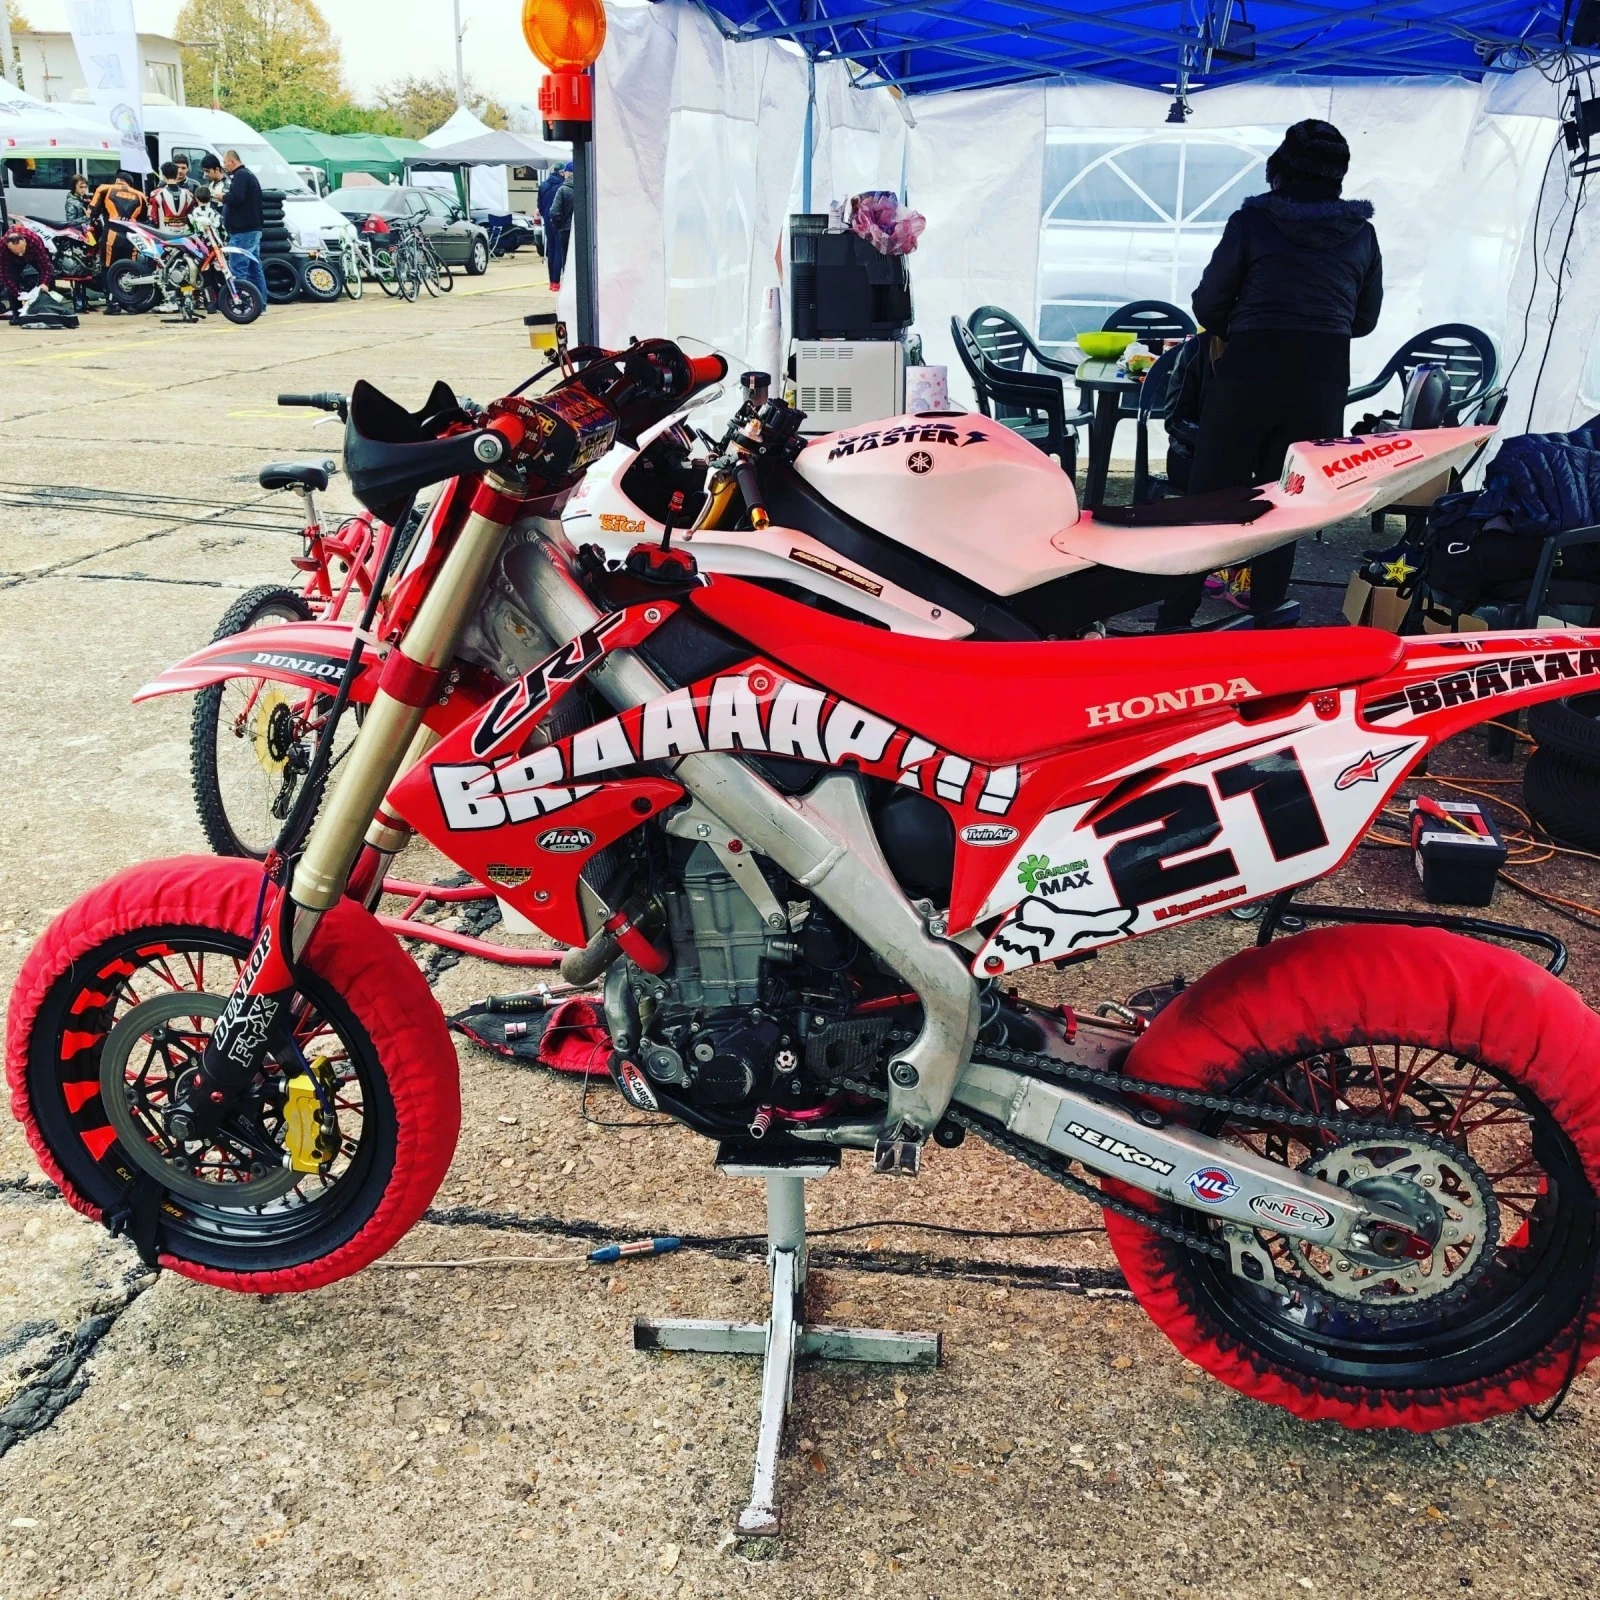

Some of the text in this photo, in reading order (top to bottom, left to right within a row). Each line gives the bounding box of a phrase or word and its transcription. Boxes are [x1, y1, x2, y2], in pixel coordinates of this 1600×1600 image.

[827, 429, 960, 464] MASTER
[1322, 438, 1413, 478] KIMBO
[472, 608, 626, 757] CRF
[1085, 677, 1261, 728] HONDA
[540, 830, 590, 845] Airoh
[1092, 746, 1330, 906] 21
[1035, 859, 1089, 880] GARDEN
[1039, 871, 1093, 896] MAX
[214, 925, 271, 1050] DUNLOP
[1064, 1121, 1176, 1176] REIKON
[1186, 1171, 1240, 1197] NILS
[1256, 1197, 1324, 1226] INNTECK
